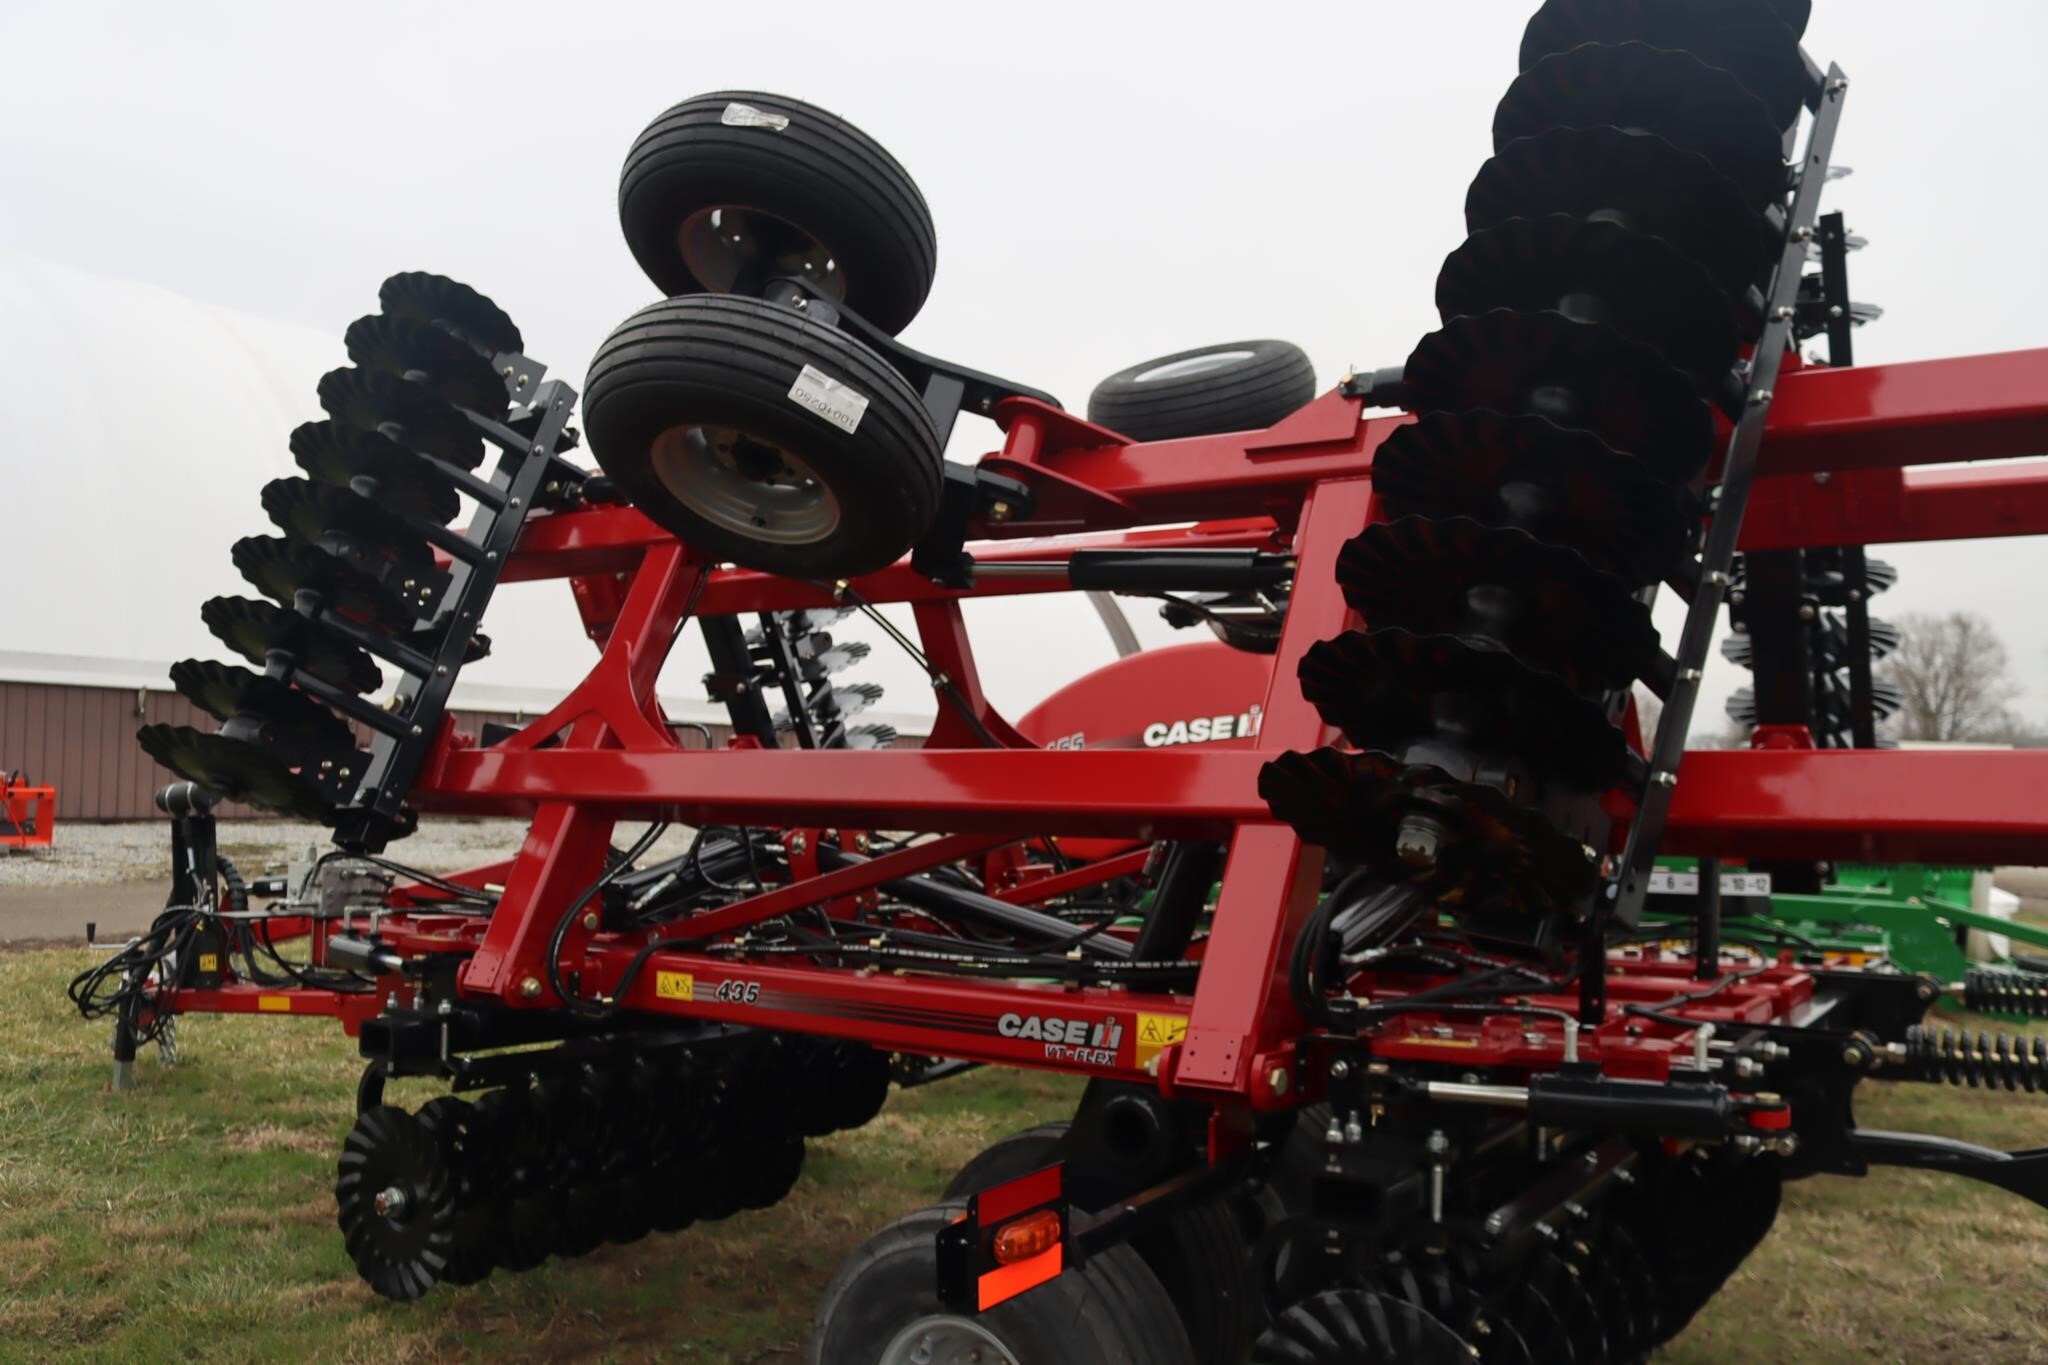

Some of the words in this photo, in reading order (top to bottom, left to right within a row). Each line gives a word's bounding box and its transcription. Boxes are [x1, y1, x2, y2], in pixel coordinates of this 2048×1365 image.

[1143, 714, 1234, 748] CASE
[716, 979, 760, 1005] 435
[998, 1012, 1088, 1046] CASE
[1092, 1016, 1123, 1050] IH
[1045, 1043, 1118, 1065] VT-FLEX
